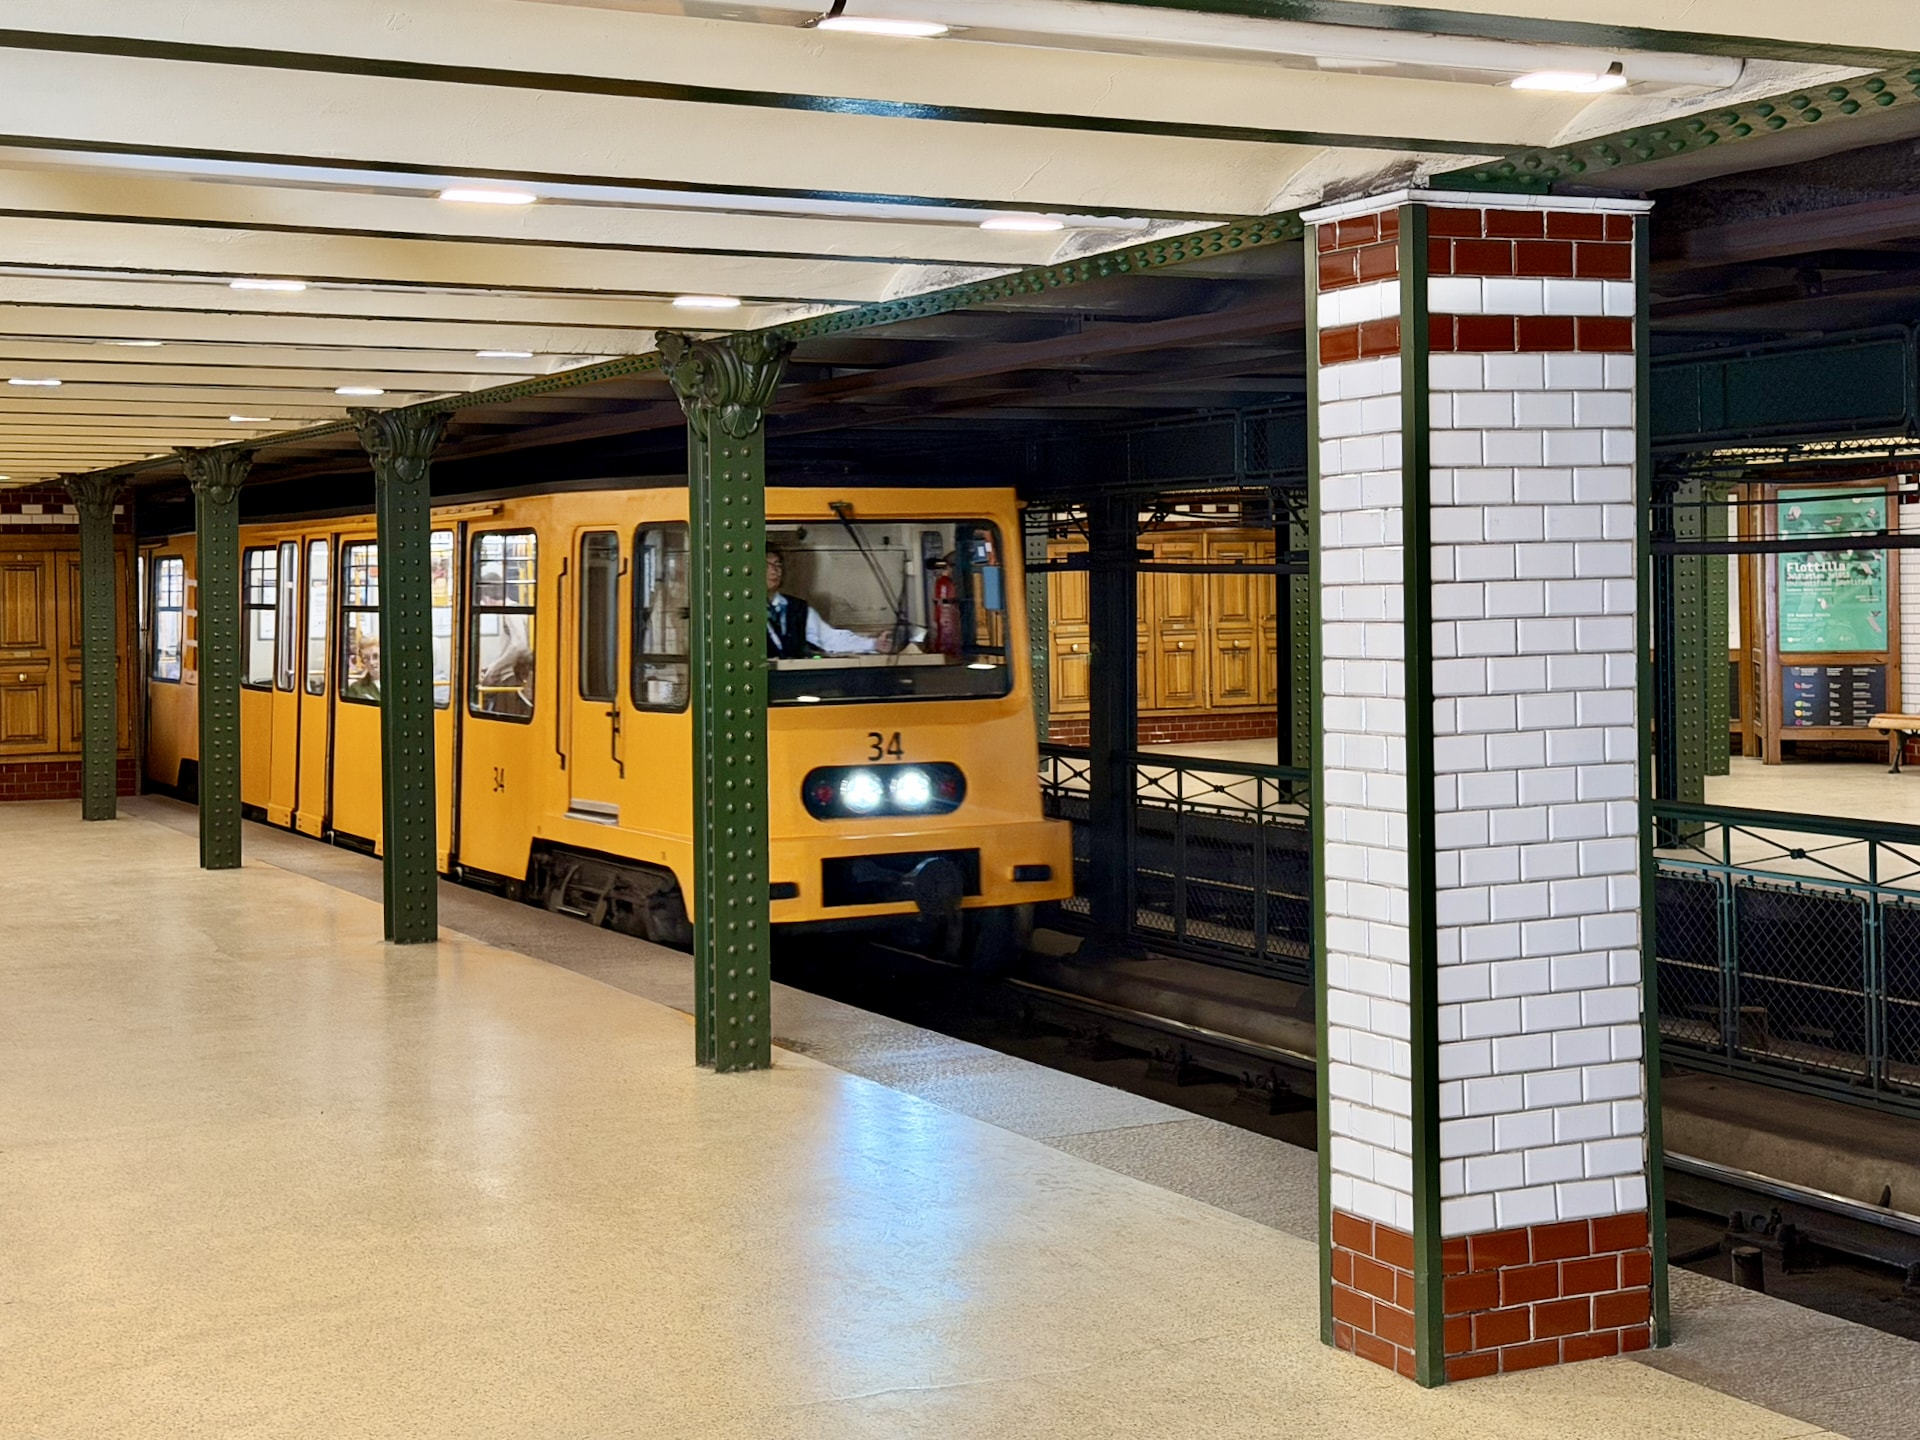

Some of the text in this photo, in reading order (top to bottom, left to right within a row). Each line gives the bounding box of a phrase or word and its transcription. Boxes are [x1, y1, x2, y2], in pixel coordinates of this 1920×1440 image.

[1786, 561, 1846, 573] Flottilla
[867, 731, 905, 762] 34
[493, 766, 505, 794] 34
